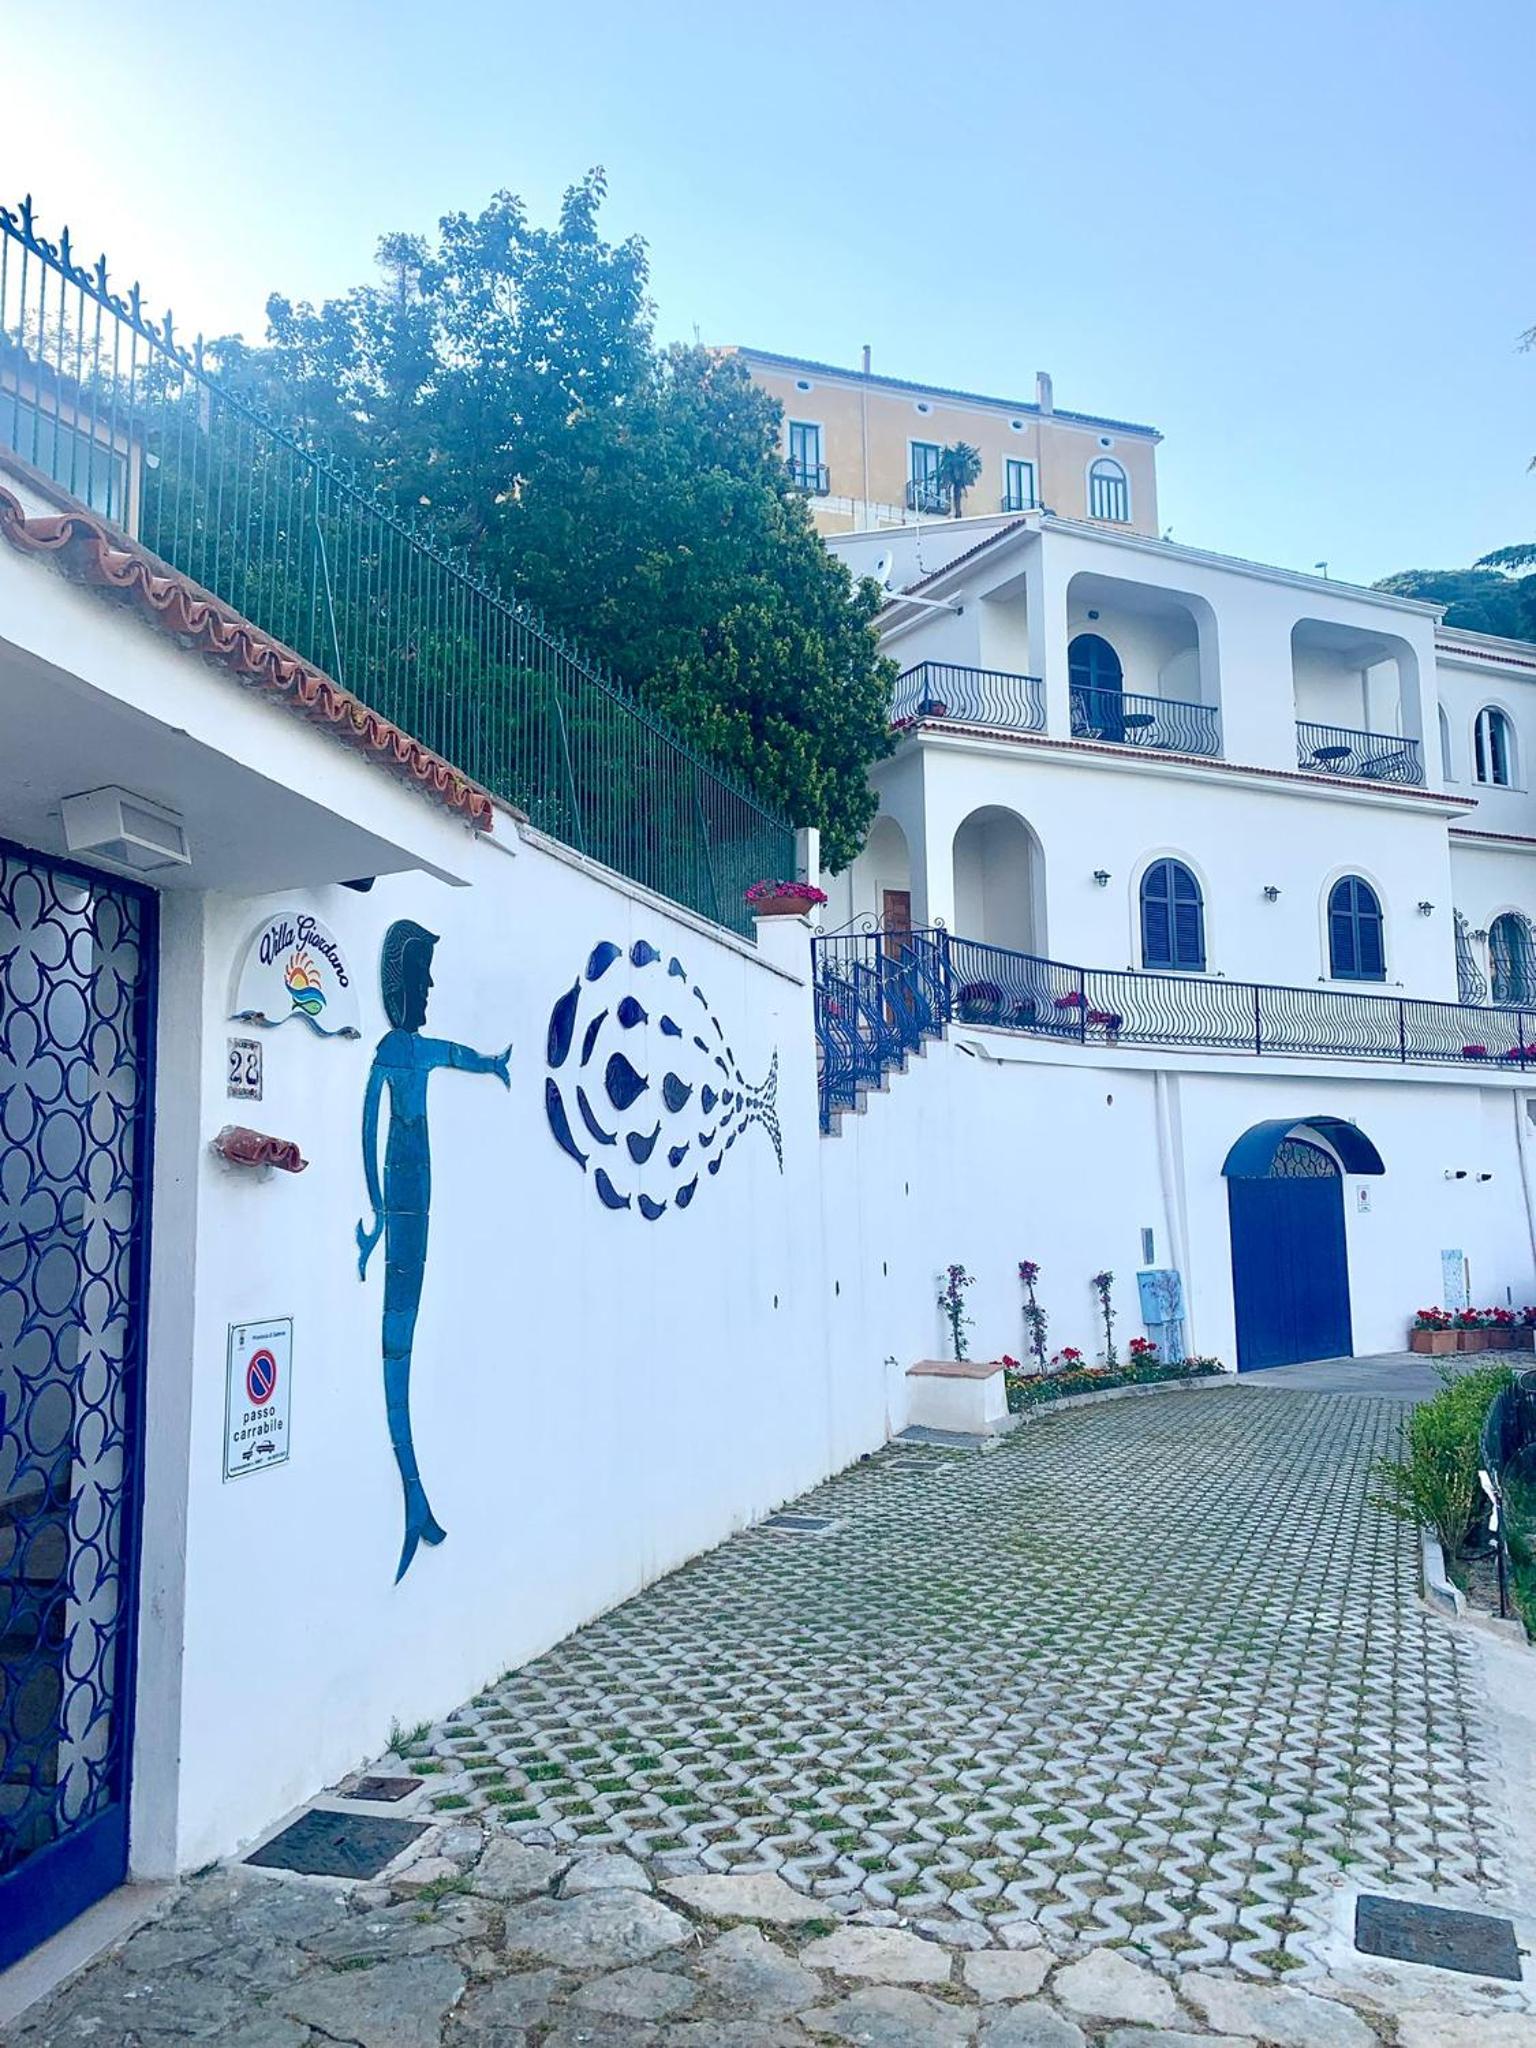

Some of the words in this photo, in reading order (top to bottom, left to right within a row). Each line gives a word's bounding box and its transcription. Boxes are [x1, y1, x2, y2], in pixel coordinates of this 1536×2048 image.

[259, 922, 296, 966] Villa
[296, 915, 349, 988] Giordano
[230, 1050, 259, 1085] 28
[233, 1418, 283, 1442] carrabile
[243, 1406, 275, 1426] passo
